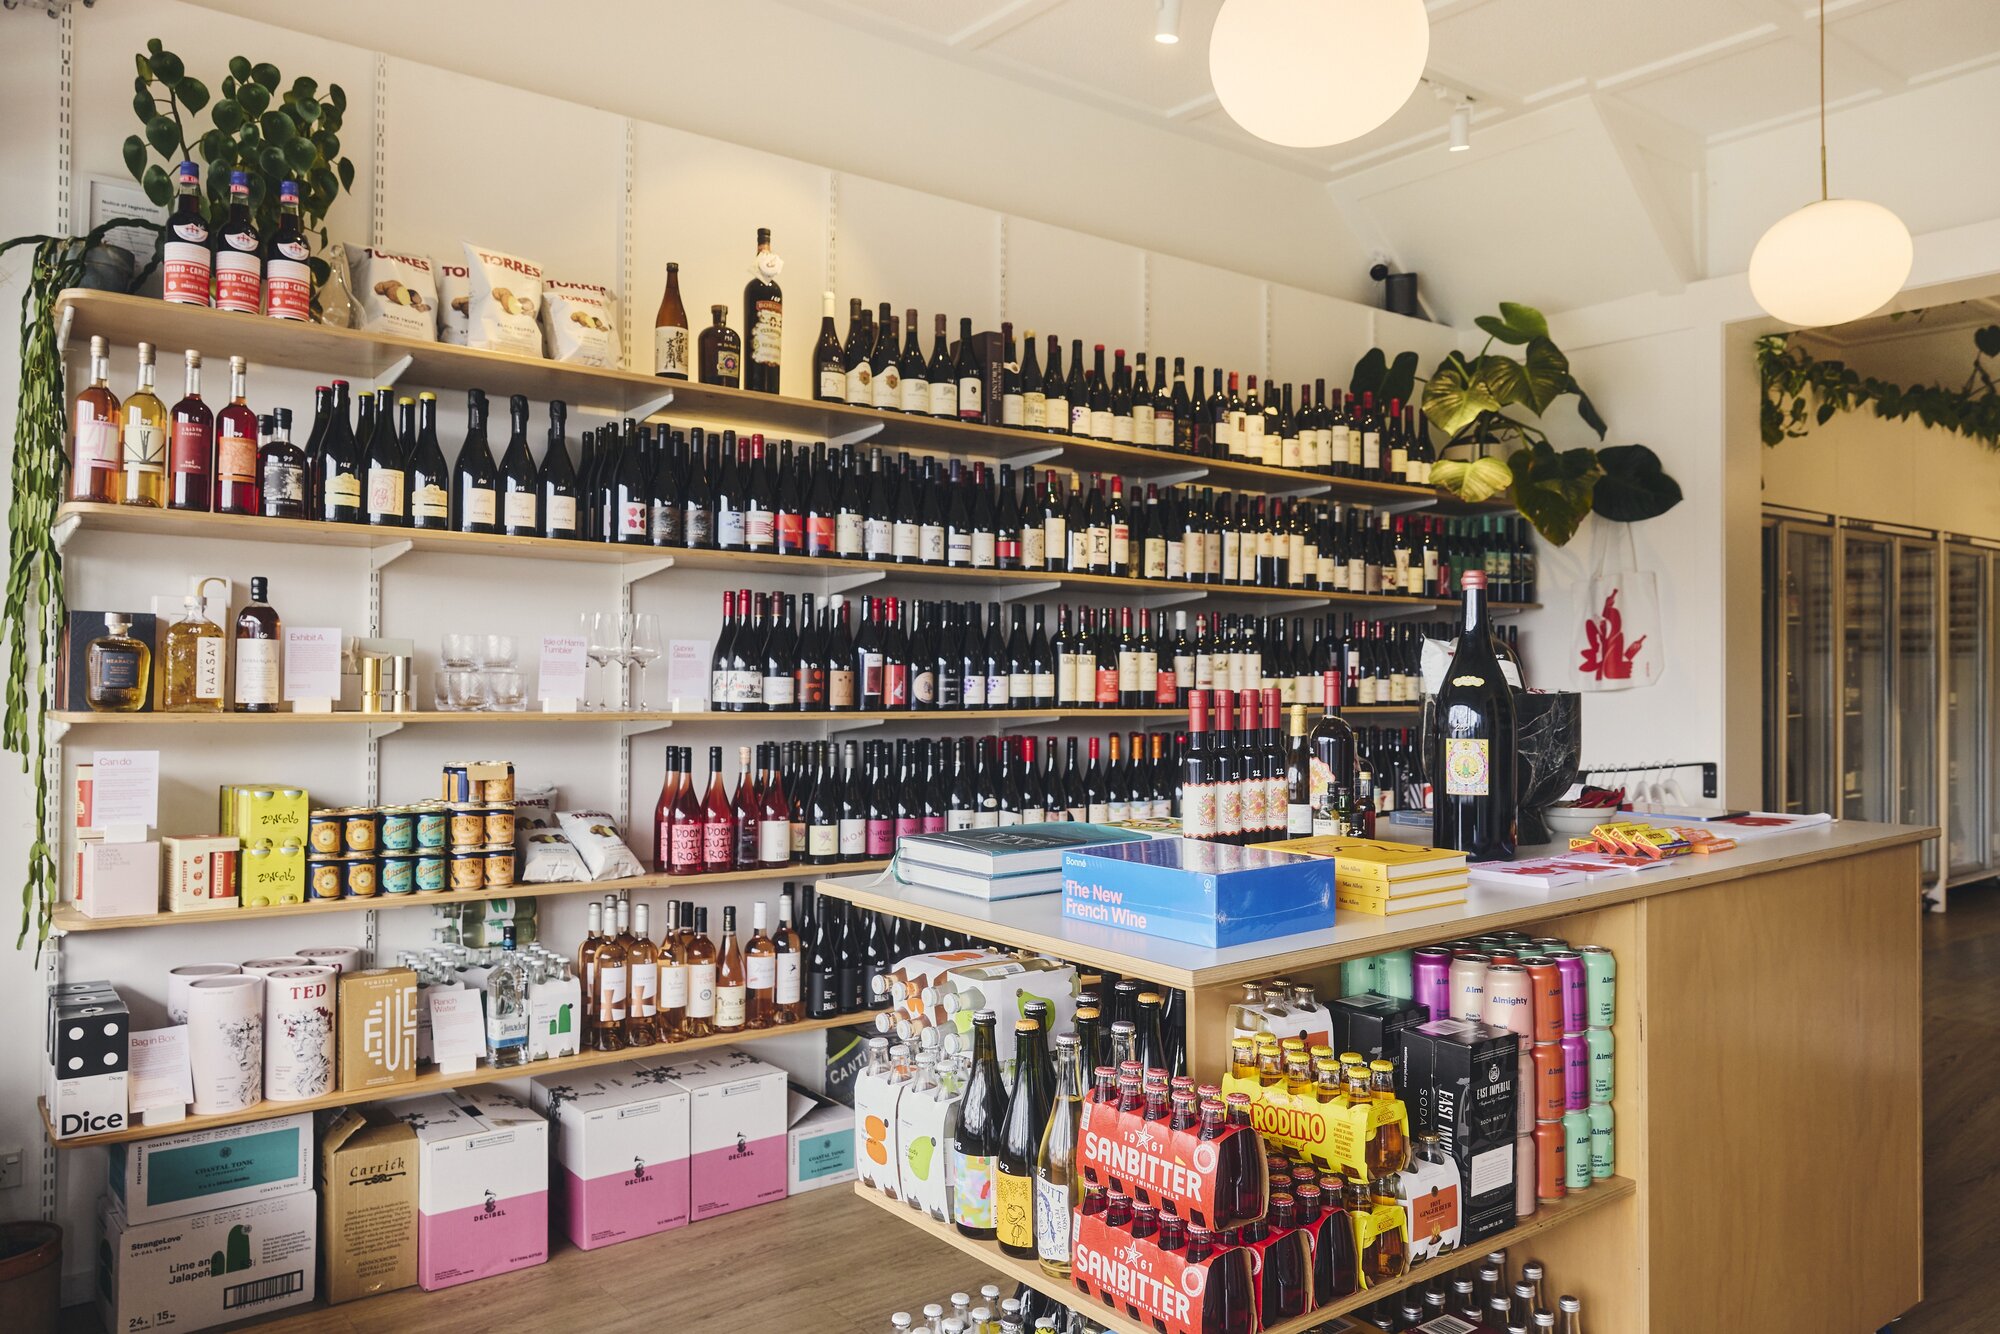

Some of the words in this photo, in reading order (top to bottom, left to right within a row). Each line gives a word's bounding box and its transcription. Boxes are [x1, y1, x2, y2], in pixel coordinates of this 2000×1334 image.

[128, 204, 159, 214] registration
[480, 253, 541, 278] TORRES
[560, 295, 602, 306] TORRES
[401, 317, 424, 327] TRUFFLE
[515, 325, 535, 334] TRUFFLE
[290, 633, 317, 641] Exhibit
[205, 640, 216, 695] RAASAY
[100, 758, 118, 766] Can
[120, 758, 132, 766] do
[1066, 856, 1087, 868] Bonné
[1066, 880, 1090, 898] The
[1092, 884, 1123, 905] New
[1066, 898, 1108, 921] French
[1112, 906, 1147, 930] Wine
[290, 984, 326, 1000] TED
[1492, 996, 1528, 1005] Almighty
[131, 1037, 149, 1047] Bag
[158, 1034, 176, 1043] Box
[1476, 1086, 1489, 1100] EAST
[1490, 1080, 1511, 1096] IMPERIAL
[1419, 1088, 1428, 1127] SODA
[1438, 1089, 1453, 1122] EAST
[62, 1111, 122, 1136] Dice
[1250, 1103, 1326, 1144] RODINO
[1480, 1116, 1493, 1126] SODA
[1494, 1113, 1507, 1121] WATER
[1124, 1131, 1135, 1143] 19
[1151, 1142, 1163, 1154] 61
[728, 1150, 754, 1161] DECIBEL
[195, 1164, 228, 1175] COASTAL
[232, 1159, 254, 1168] TONIC
[350, 1158, 406, 1178] Carrick
[1000, 1161, 1010, 1173] 42
[1038, 1167, 1046, 1178] 35
[625, 1175, 653, 1186] DECIBEL
[1112, 1169, 1134, 1182] ROSSO
[1137, 1178, 1180, 1200] INIMITABILE
[1420, 1208, 1438, 1218] GINGER
[1438, 1202, 1452, 1212] BEER
[1430, 1199, 1441, 1208] HOT
[474, 1210, 506, 1222] DECIBEL
[131, 1235, 181, 1250] StrangeLove
[1114, 1247, 1125, 1260] 19
[1140, 1260, 1152, 1272] 61
[169, 1262, 195, 1273] Lime
[1103, 1283, 1125, 1298] ROSSO
[1126, 1295, 1169, 1320] INIMITABILE
[129, 1316, 144, 1328] 24
[157, 1310, 169, 1321] 15
